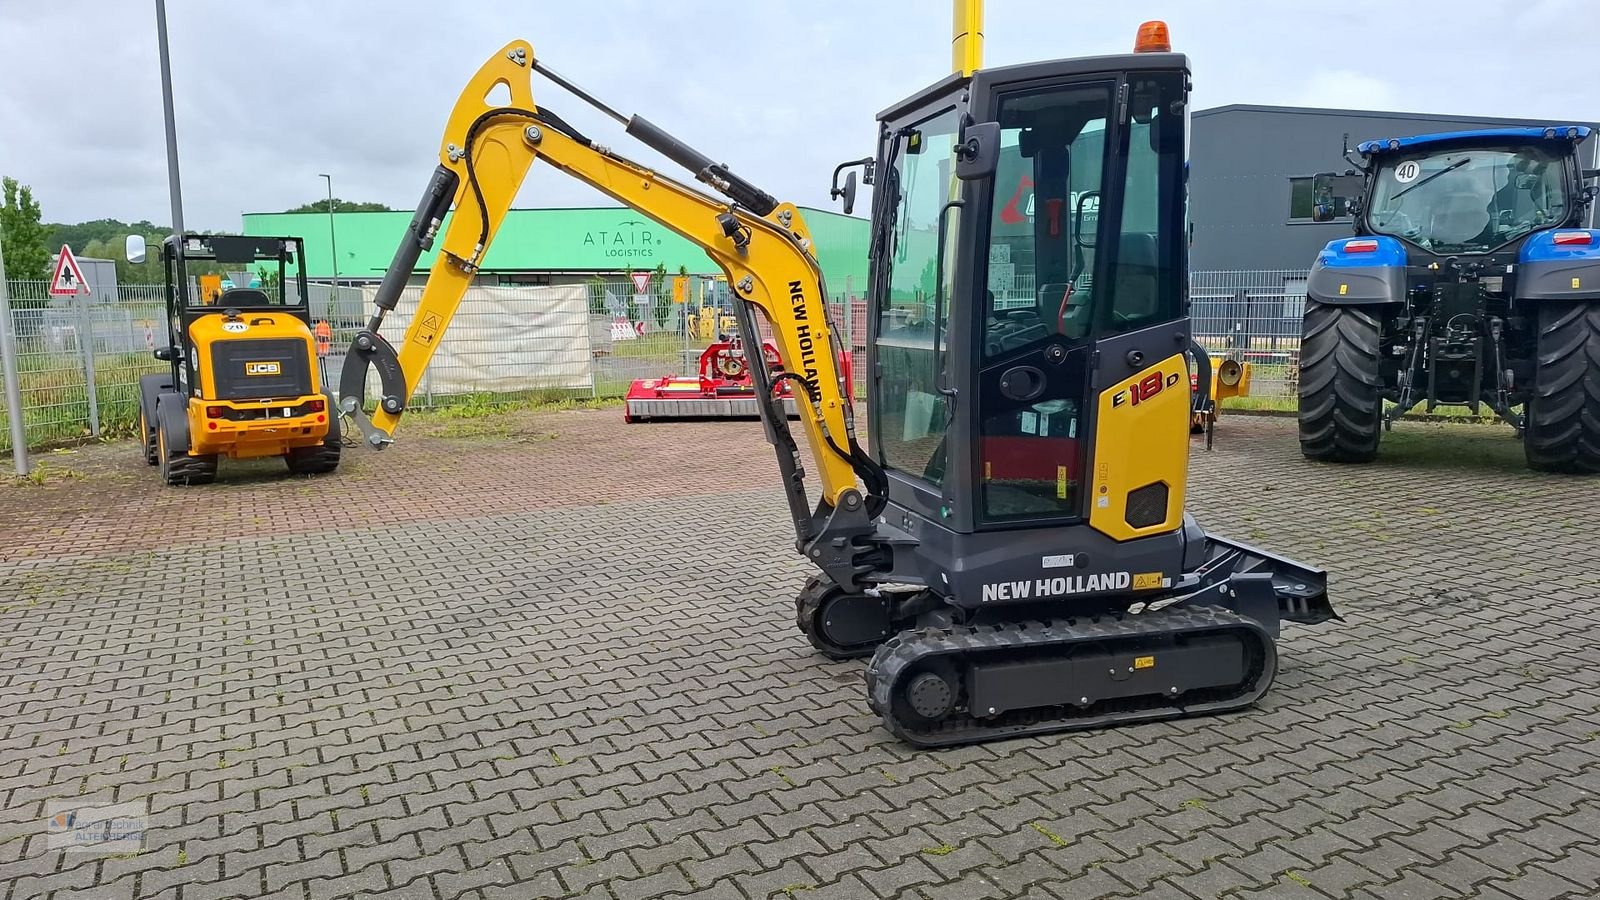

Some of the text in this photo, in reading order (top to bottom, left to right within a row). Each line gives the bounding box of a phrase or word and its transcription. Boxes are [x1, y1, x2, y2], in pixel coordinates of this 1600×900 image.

[1399, 164, 1415, 179] 40
[605, 248, 653, 257] LOGISTICS
[788, 280, 808, 321] NEW
[249, 363, 279, 373] JCB
[982, 571, 1130, 602] NEW HOLLAND
